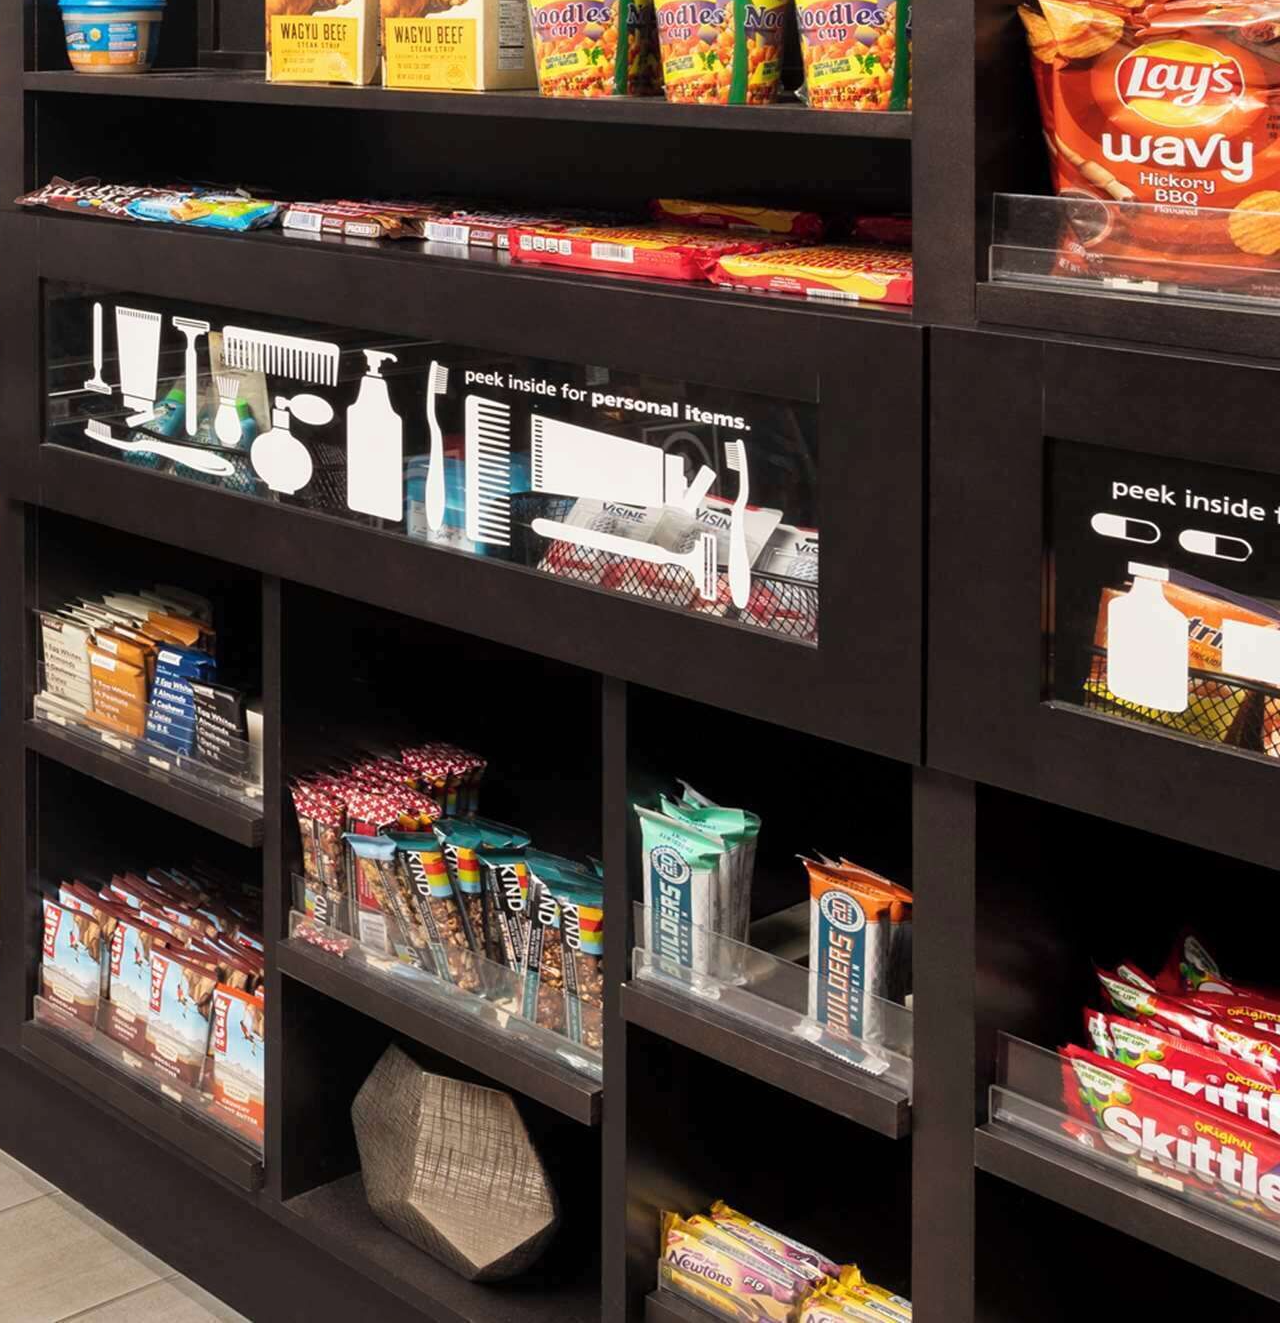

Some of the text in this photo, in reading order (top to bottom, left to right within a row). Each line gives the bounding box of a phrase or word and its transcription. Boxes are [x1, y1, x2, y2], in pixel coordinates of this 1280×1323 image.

[281, 23, 348, 42] WAGYU BEEF
[394, 26, 464, 45] WAGYU BEEF
[551, 25, 577, 38] cup
[668, 27, 691, 39] cup
[817, 27, 847, 41] cup
[1127, 58, 1234, 107] Lay's
[1102, 133, 1254, 184] wavy
[1140, 172, 1216, 194] Hickory
[1156, 189, 1198, 206] BBQ
[465, 370, 751, 431] peek inside for personal items.
[1112, 481, 1177, 506] peek
[1185, 490, 1266, 521] inside
[696, 508, 731, 530] VISIN
[406, 850, 432, 896] KIND
[499, 864, 524, 911] KIND
[562, 903, 581, 949] KIND
[1195, 1121, 1254, 1154] ORIGINAL
[668, 1250, 733, 1286] Newtons
[743, 1275, 765, 1291] Fig
